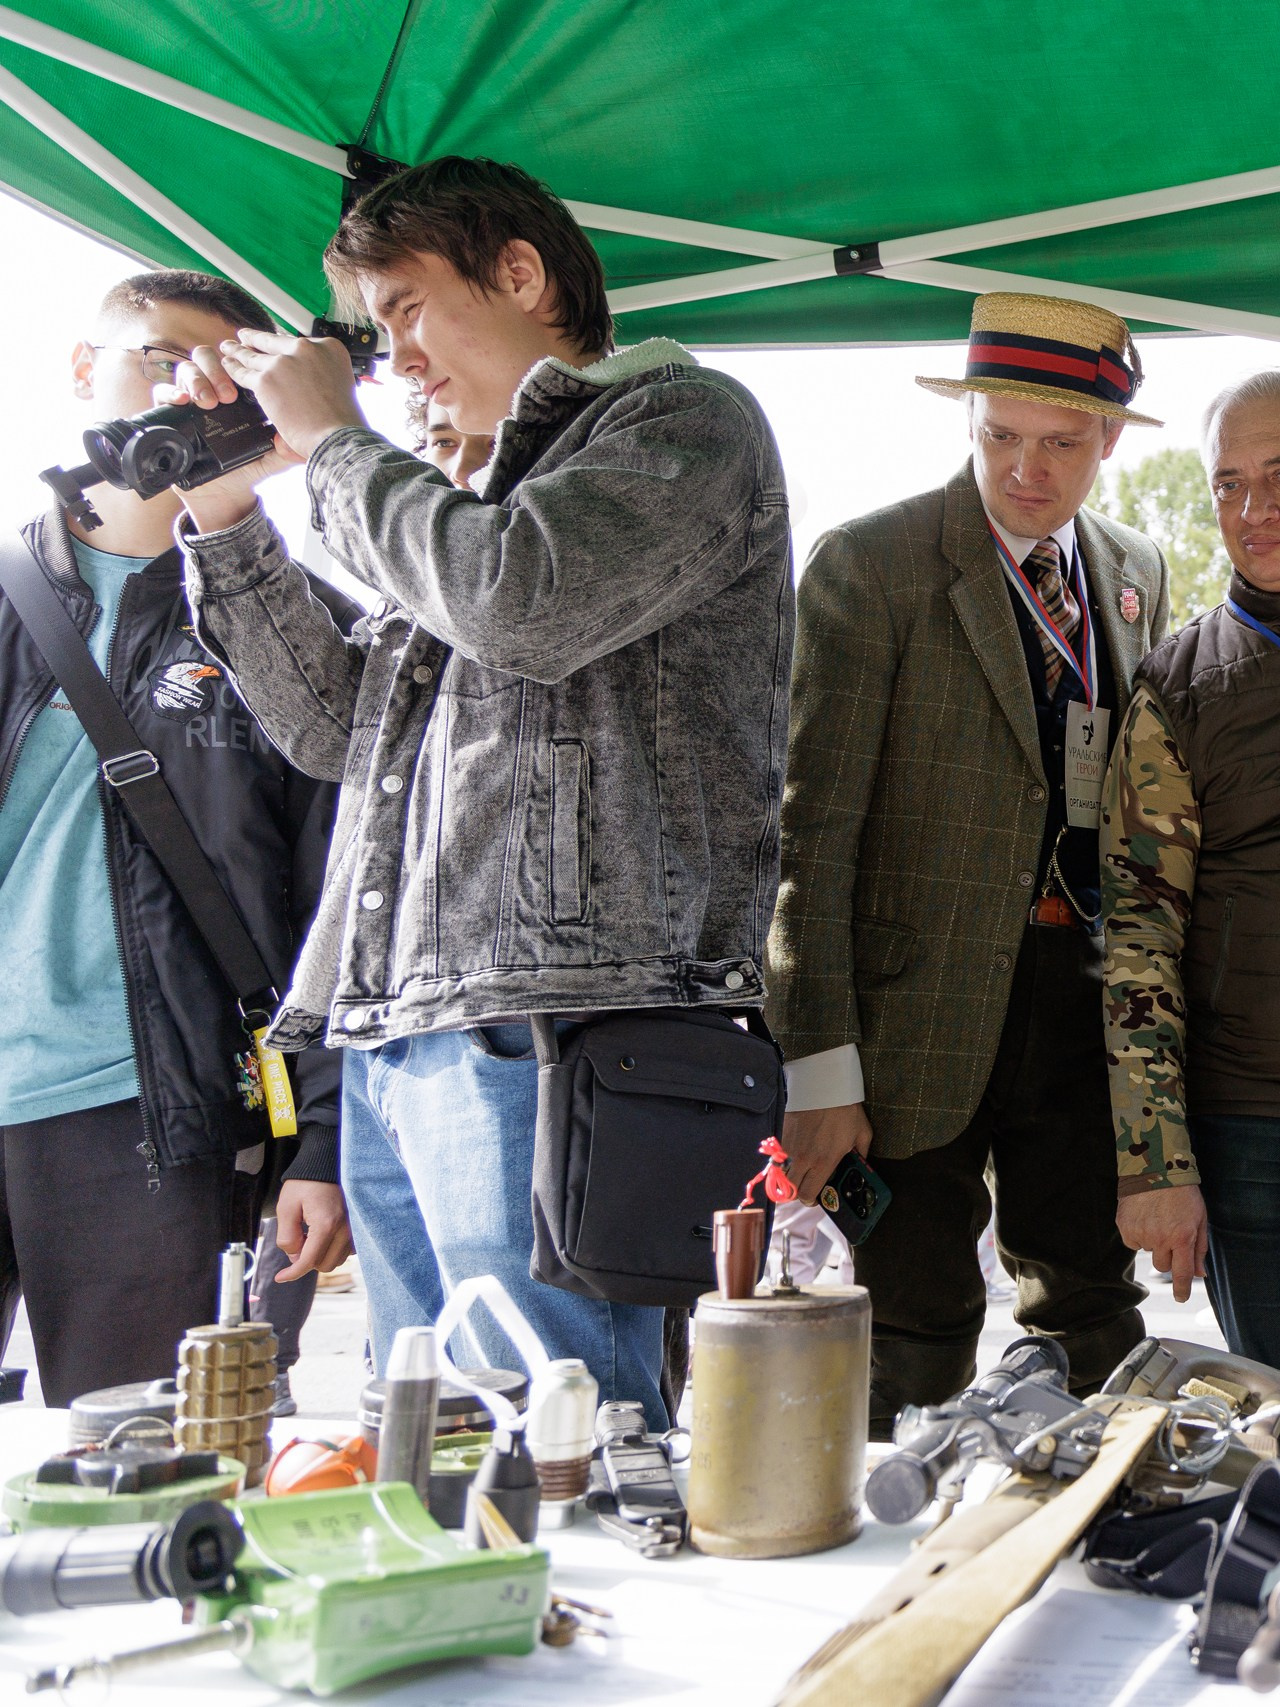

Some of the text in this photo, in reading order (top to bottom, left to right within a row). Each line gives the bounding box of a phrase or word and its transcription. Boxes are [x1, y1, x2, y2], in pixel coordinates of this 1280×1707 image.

[158, 686, 201, 709] FASHION WEAR
[1068, 746, 1107, 763] УРАЛЬСКИЕ
[1076, 762, 1099, 776] ГЕРОИ
[1069, 798, 1101, 811] ОРГАНИЗАТ
[268, 1063, 288, 1104] ONE PIECE
